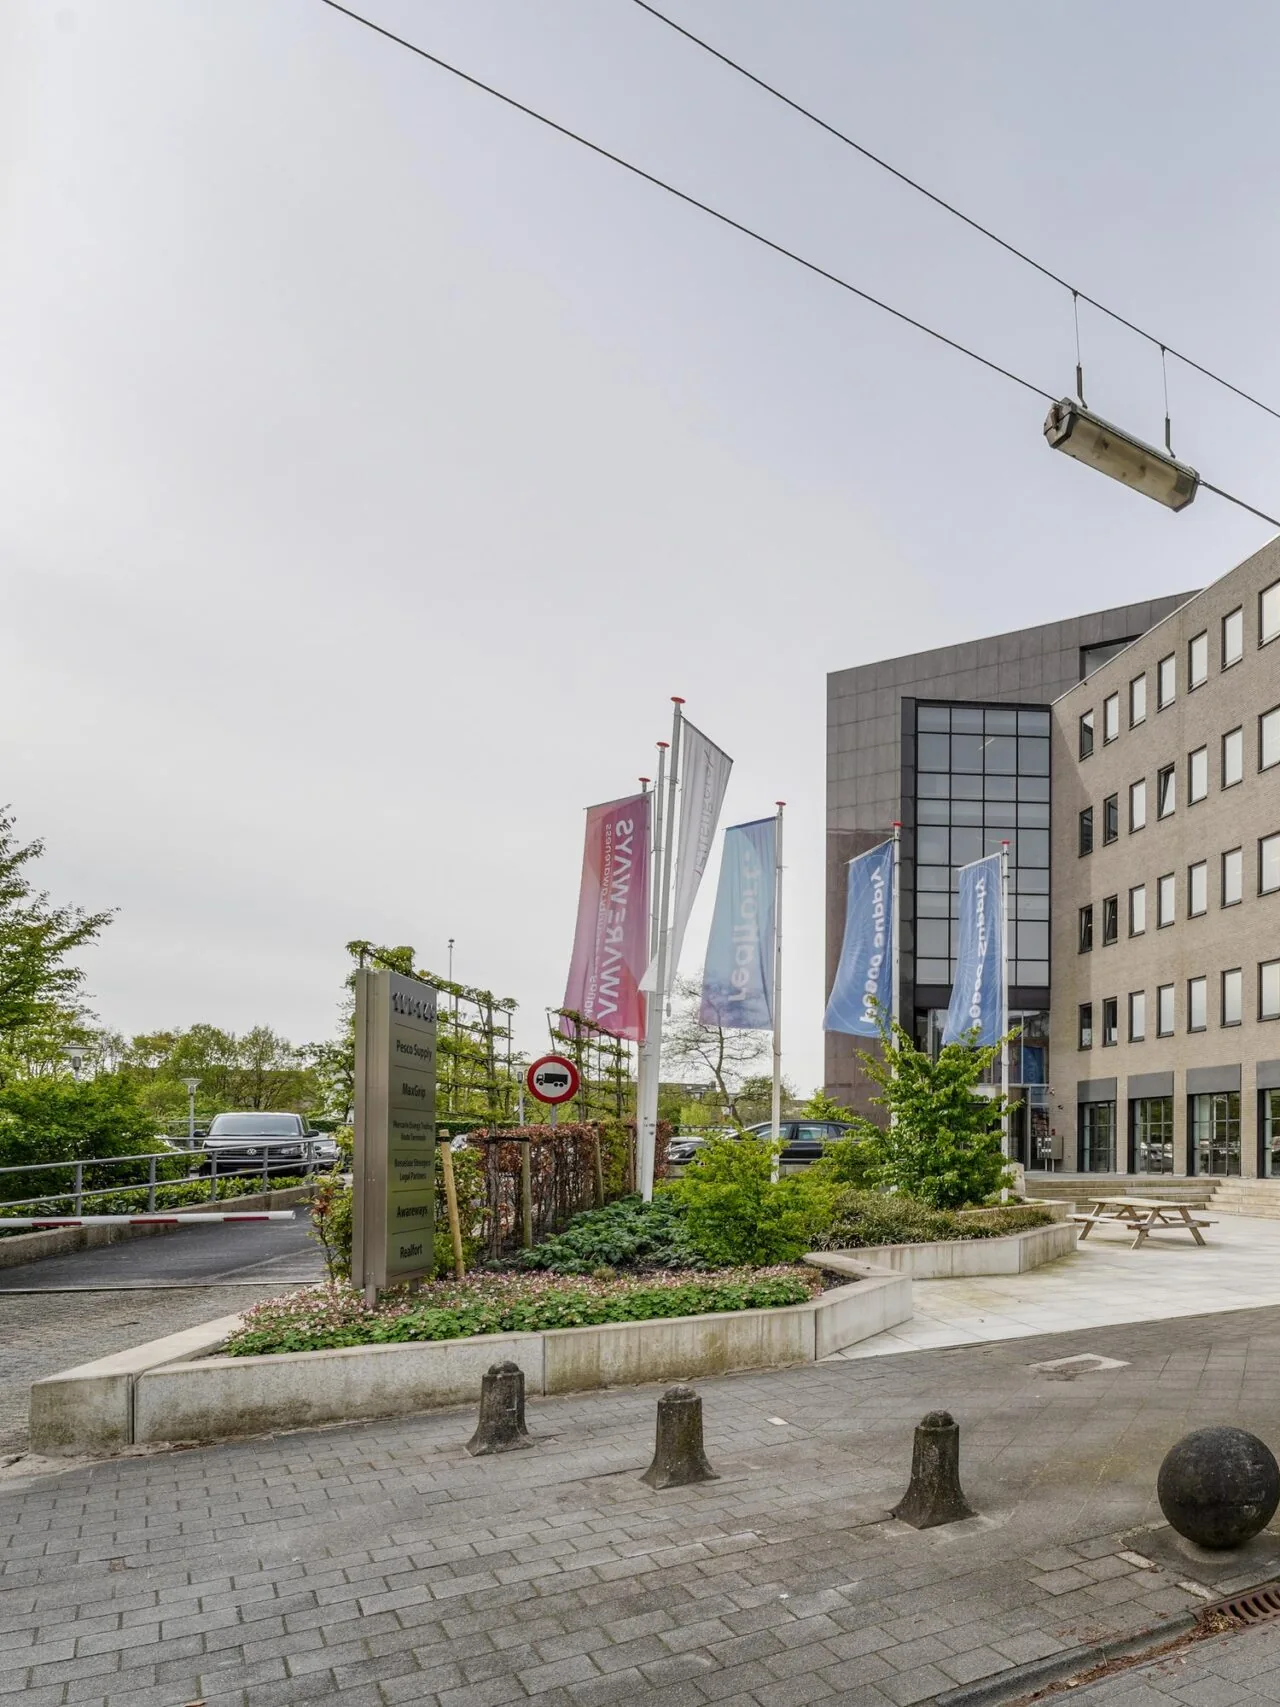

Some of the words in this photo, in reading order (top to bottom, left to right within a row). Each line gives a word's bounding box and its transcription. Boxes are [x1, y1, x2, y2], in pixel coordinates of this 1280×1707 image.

[396, 1039, 413, 1056] Pesco
[413, 1043, 432, 1062] Supply
[402, 1082, 426, 1101] MaxGrip
[396, 1204, 428, 1218] Awareways
[400, 1242, 423, 1259] Realfort
